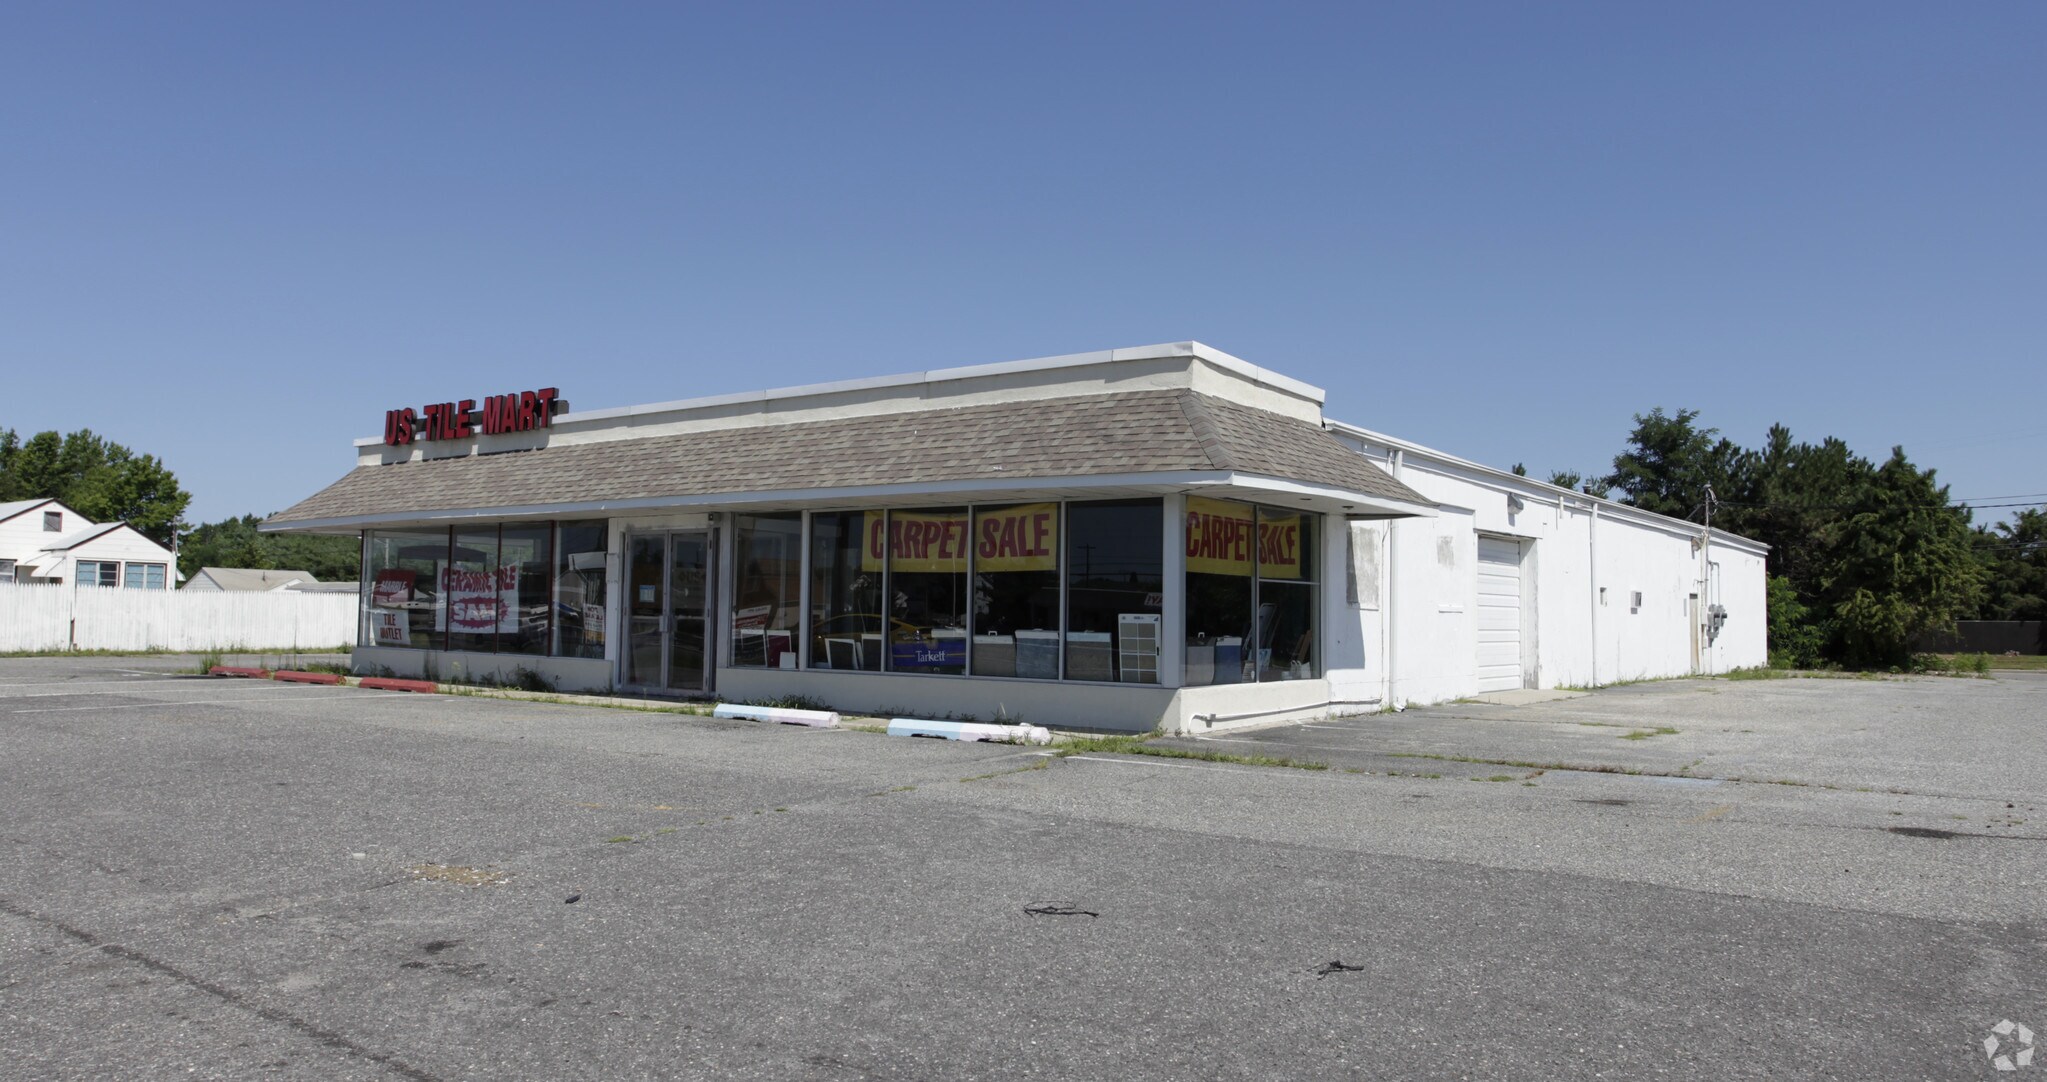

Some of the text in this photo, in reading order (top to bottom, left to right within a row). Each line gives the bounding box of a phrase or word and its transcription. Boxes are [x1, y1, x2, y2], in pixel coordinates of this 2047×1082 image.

[384, 387, 558, 446] US TILE MART
[870, 513, 1050, 560] CARPET SALE
[1186, 511, 1296, 565] CARPET SALE
[441, 567, 493, 593] CERAMIC
[383, 613, 396, 626] TILE
[915, 649, 946, 663] Tarkett
